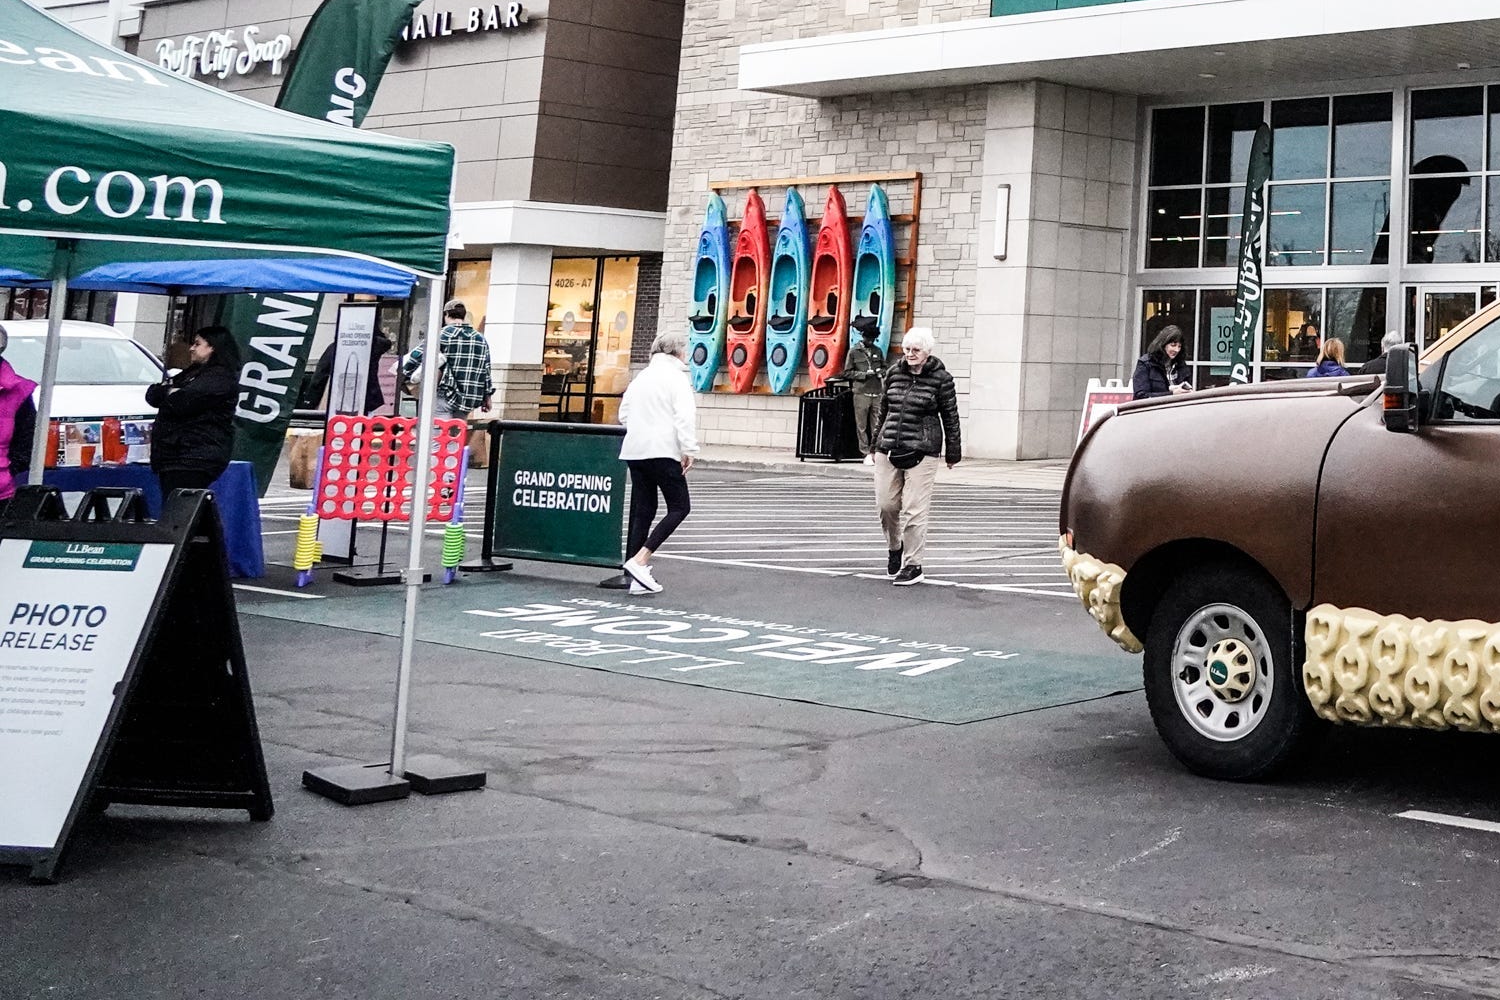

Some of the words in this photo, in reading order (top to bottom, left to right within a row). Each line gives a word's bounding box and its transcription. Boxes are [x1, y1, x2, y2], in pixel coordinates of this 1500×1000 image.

[466, 1, 522, 33] BAR
[201, 30, 238, 80] City
[236, 25, 291, 75] Soap
[554, 278, 575, 288] 4026
[581, 277, 593, 288] A7
[234, 292, 320, 424] GRAN
[514, 469, 556, 488] GRAND
[557, 473, 613, 492] OPENING
[512, 488, 611, 514] CELEBRATION
[30, 556, 55, 564] GRAND
[55, 556, 86, 565] OPENING
[86, 557, 133, 566] CELEBRATION
[9, 602, 107, 628] PHOTO
[561, 597, 687, 616] GROUNDS
[683, 613, 826, 634] STOMPING
[0, 631, 98, 652] RELEASE
[462, 603, 966, 677] WELCOME
[820, 631, 902, 644] NEW
[898, 640, 971, 653] OUR
[479, 628, 745, 672] L.L.Bean
[971, 650, 1021, 660] TO
